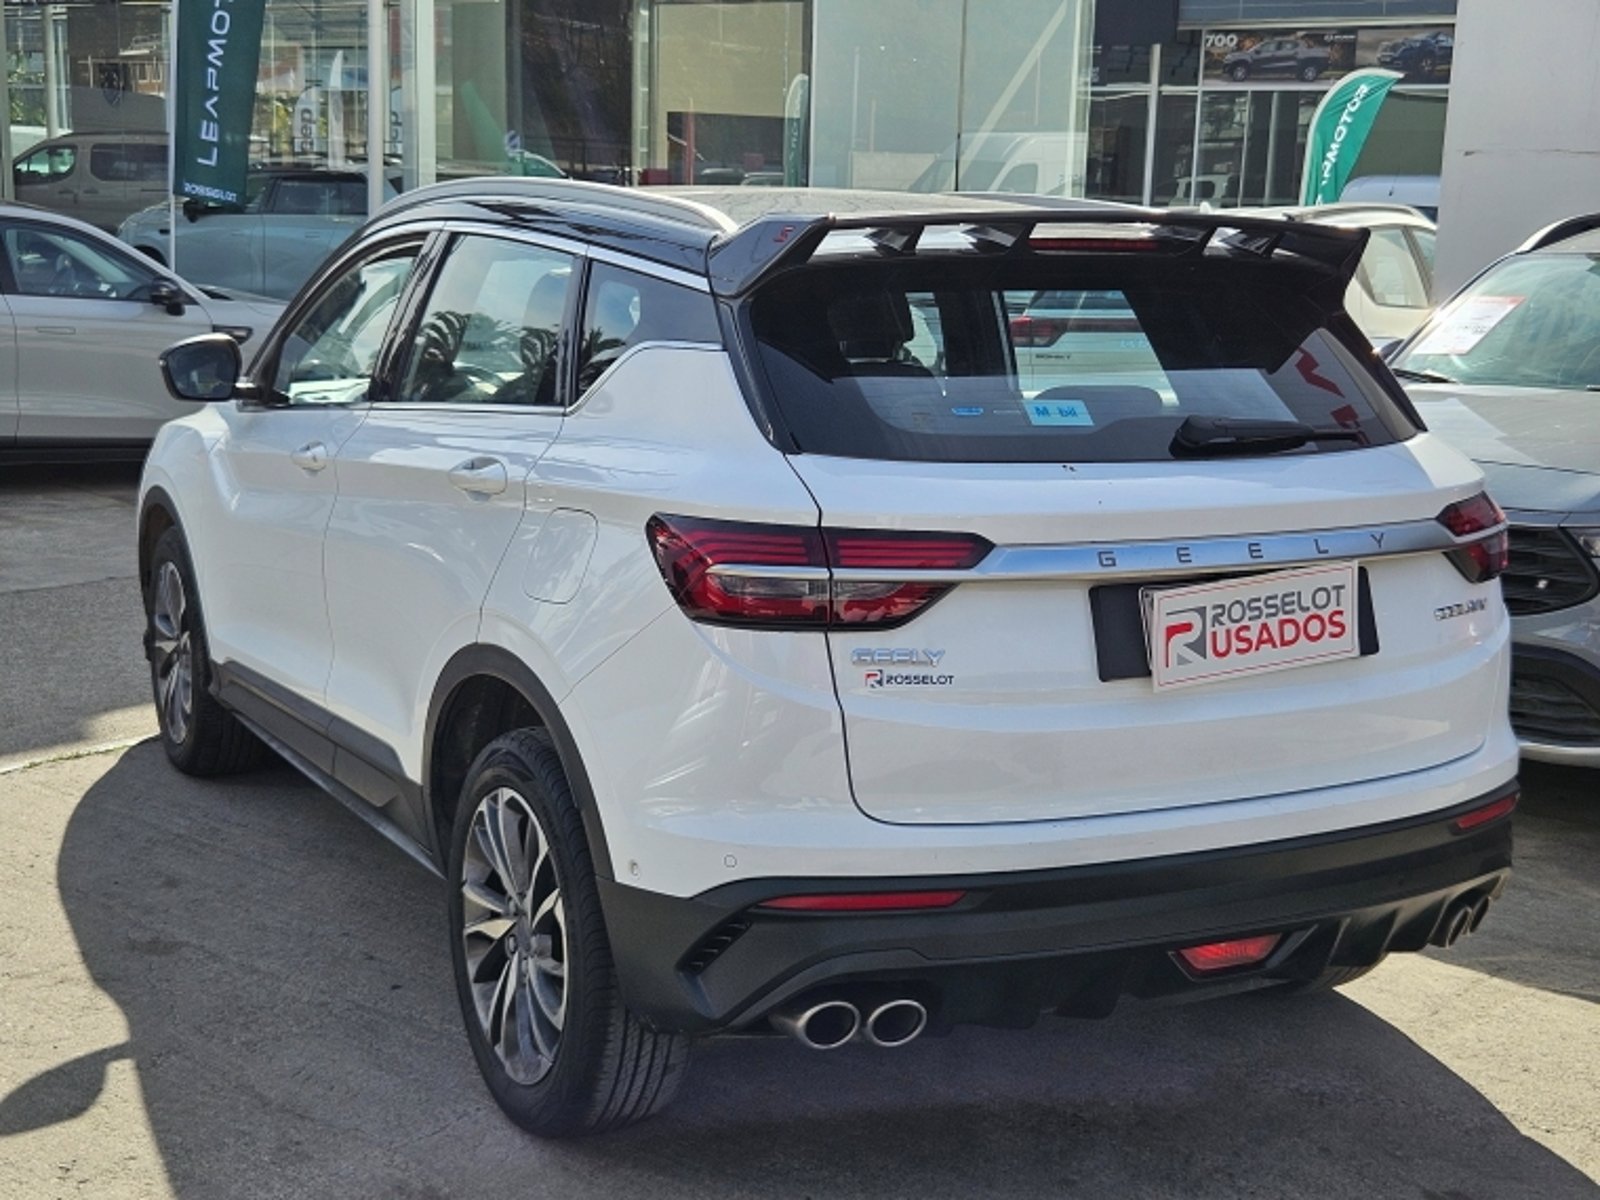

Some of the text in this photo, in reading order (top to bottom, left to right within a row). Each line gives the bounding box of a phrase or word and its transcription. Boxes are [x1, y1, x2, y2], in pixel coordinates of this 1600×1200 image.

[1205, 34, 1238, 47] 700
[1098, 532, 1385, 568] GEELY
[1211, 584, 1346, 628] ROSSELOT
[1211, 609, 1347, 658] USADOS
[851, 647, 946, 667] GEELY
[885, 674, 955, 686] ROSSELOT
